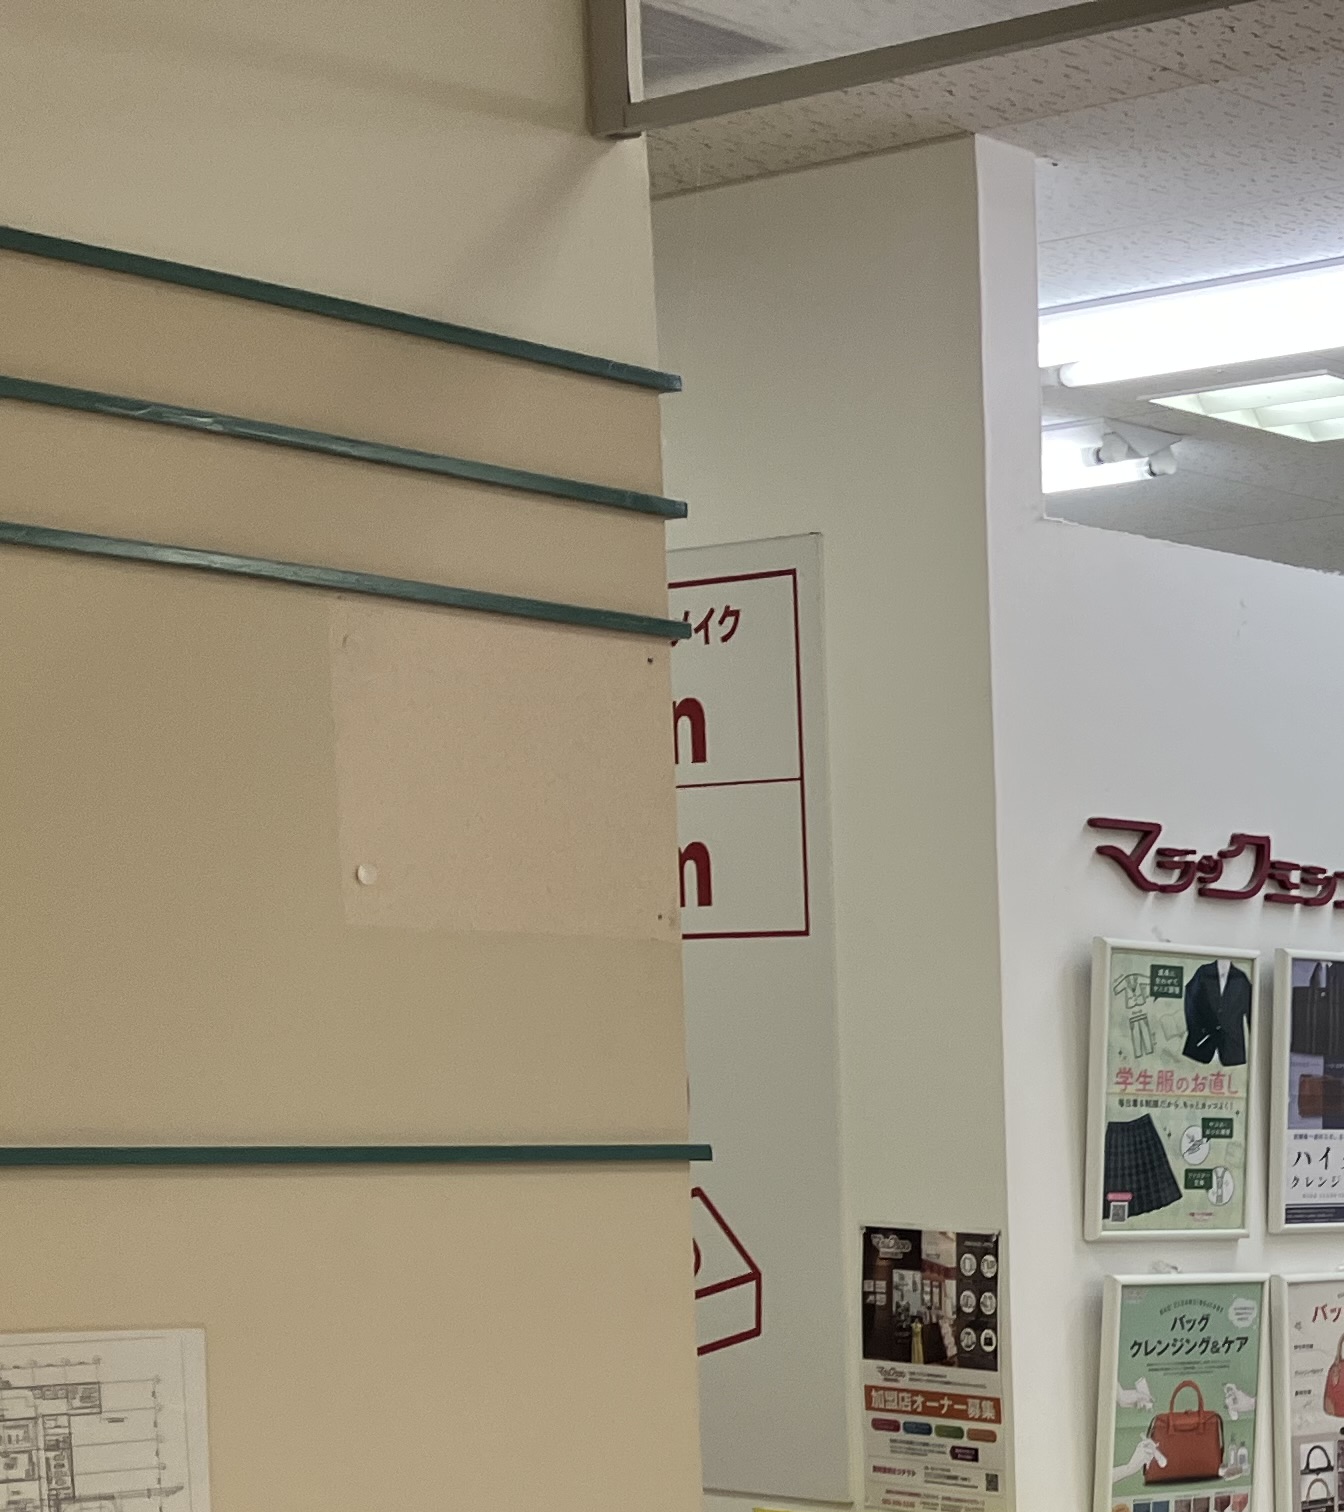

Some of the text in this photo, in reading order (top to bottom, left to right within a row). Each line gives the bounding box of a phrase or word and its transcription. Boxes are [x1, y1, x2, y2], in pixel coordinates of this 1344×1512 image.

[1114, 1066, 1241, 1096] 学生服のお直し
[1169, 1313, 1211, 1332] バッグ
[1129, 1335, 1250, 1357] クレンジング&ケア
[870, 1388, 996, 1421] 加盟店オーナー募集
